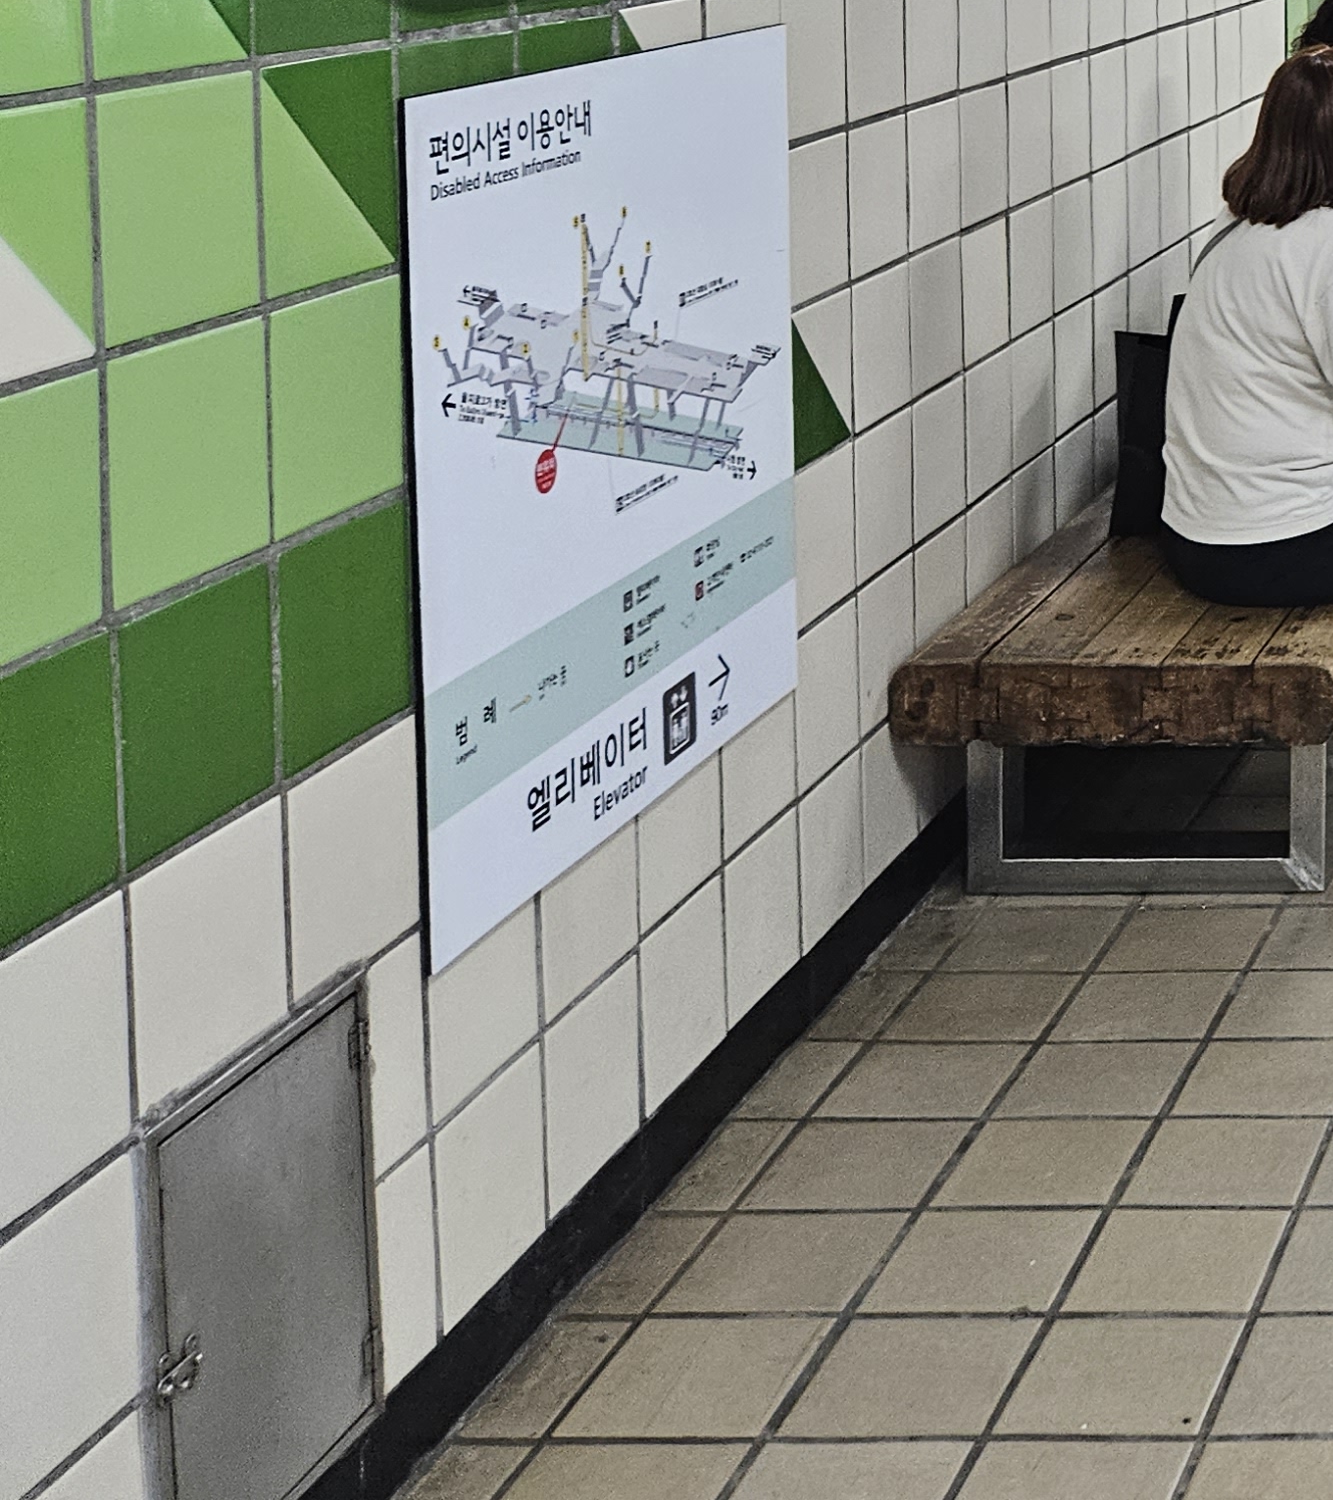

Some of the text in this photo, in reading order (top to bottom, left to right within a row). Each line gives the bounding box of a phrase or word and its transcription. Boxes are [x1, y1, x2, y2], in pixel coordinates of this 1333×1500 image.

[429, 99, 592, 176] 편의시설 이용안내
[430, 149, 582, 201] Disabled Access Information
[526, 706, 648, 833] 엘리베이터
[593, 765, 648, 822] Elevator
